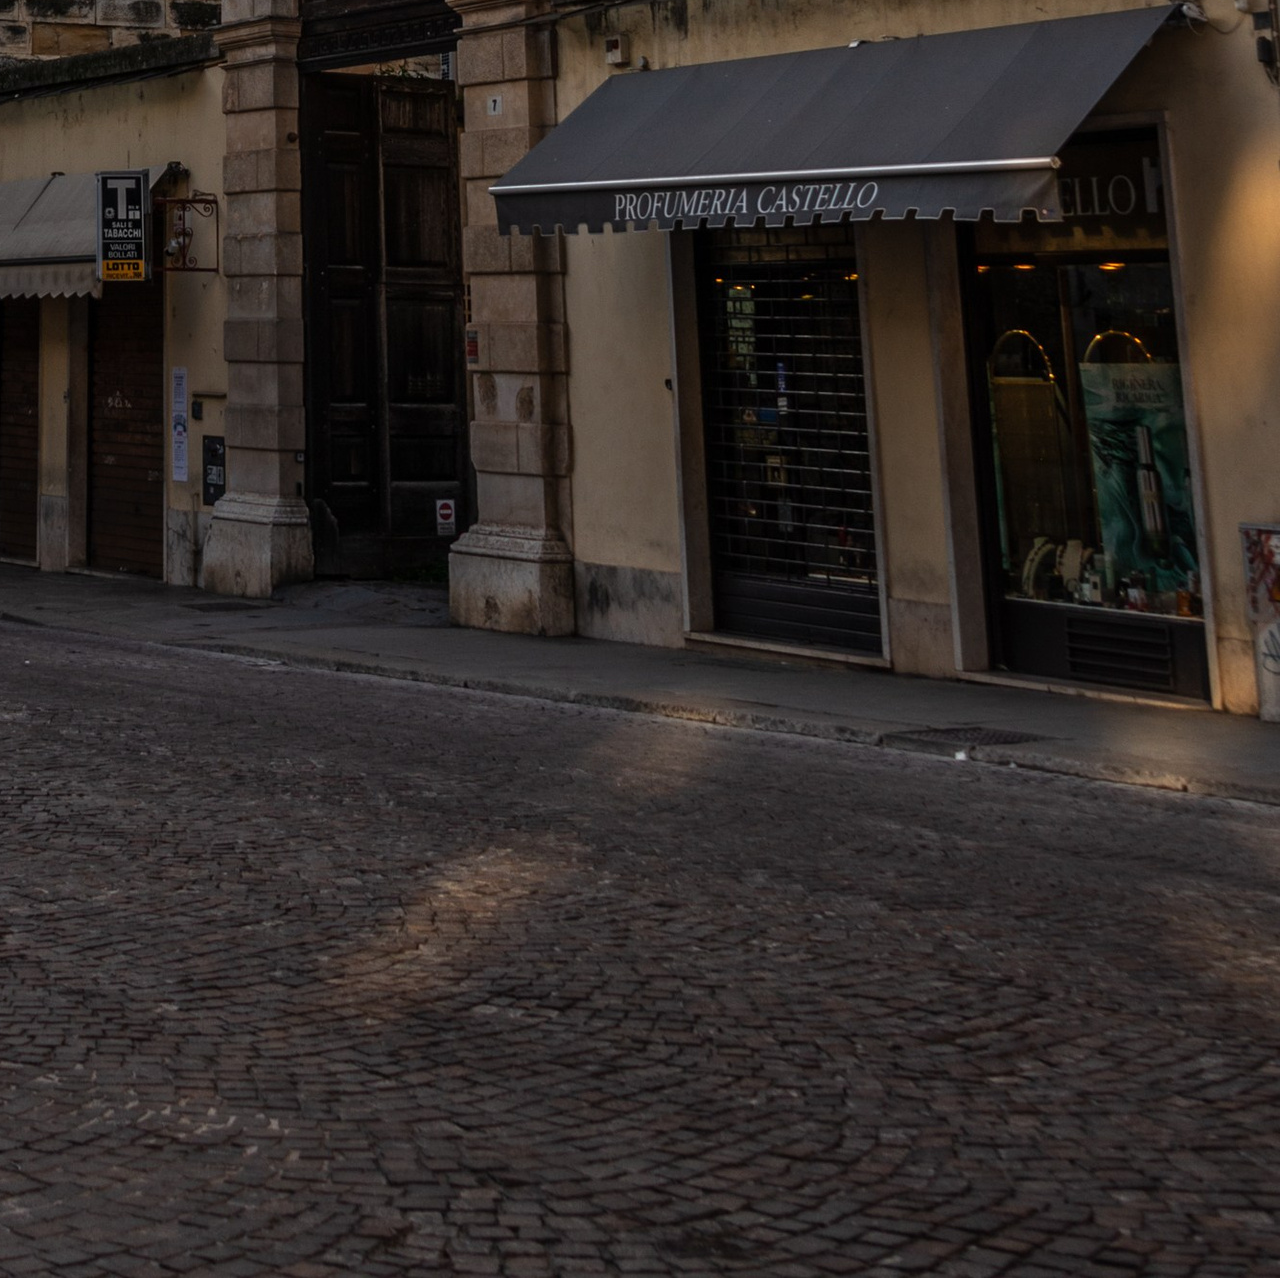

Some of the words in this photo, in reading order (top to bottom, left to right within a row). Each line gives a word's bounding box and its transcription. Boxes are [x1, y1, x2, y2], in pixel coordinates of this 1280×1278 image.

[491, 99, 498, 112] 7
[107, 179, 136, 220] T
[613, 187, 748, 221] PROFUMERIA
[756, 182, 879, 214] CASTELLO
[112, 221, 127, 229] SALI
[104, 228, 142, 238] TABACCHI
[110, 243, 136, 251] VALORI
[108, 251, 138, 259] BOLLATI
[106, 262, 140, 271] LOTTO
